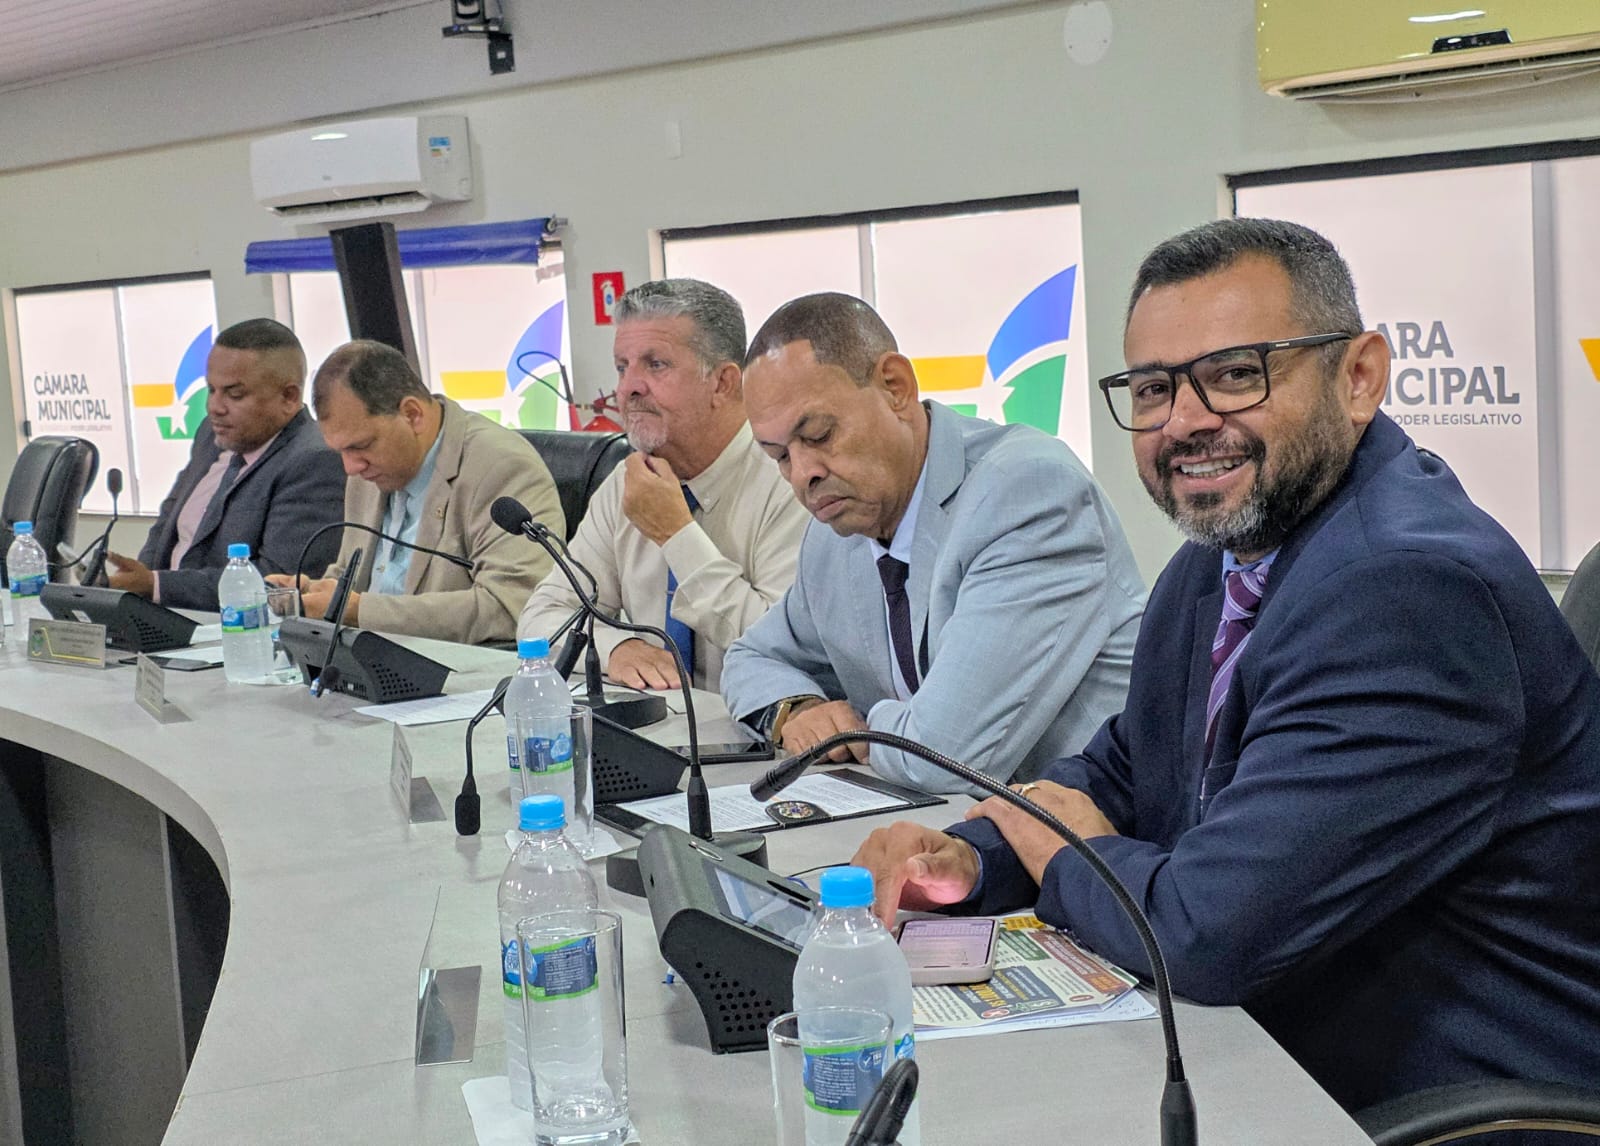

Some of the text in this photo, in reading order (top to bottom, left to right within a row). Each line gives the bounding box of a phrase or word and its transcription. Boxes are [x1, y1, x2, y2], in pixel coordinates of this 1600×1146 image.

[34, 371, 89, 395] CÂMARA
[38, 399, 111, 421] MUNICIPAL
[1434, 413, 1522, 425] LEGISLATIVO
